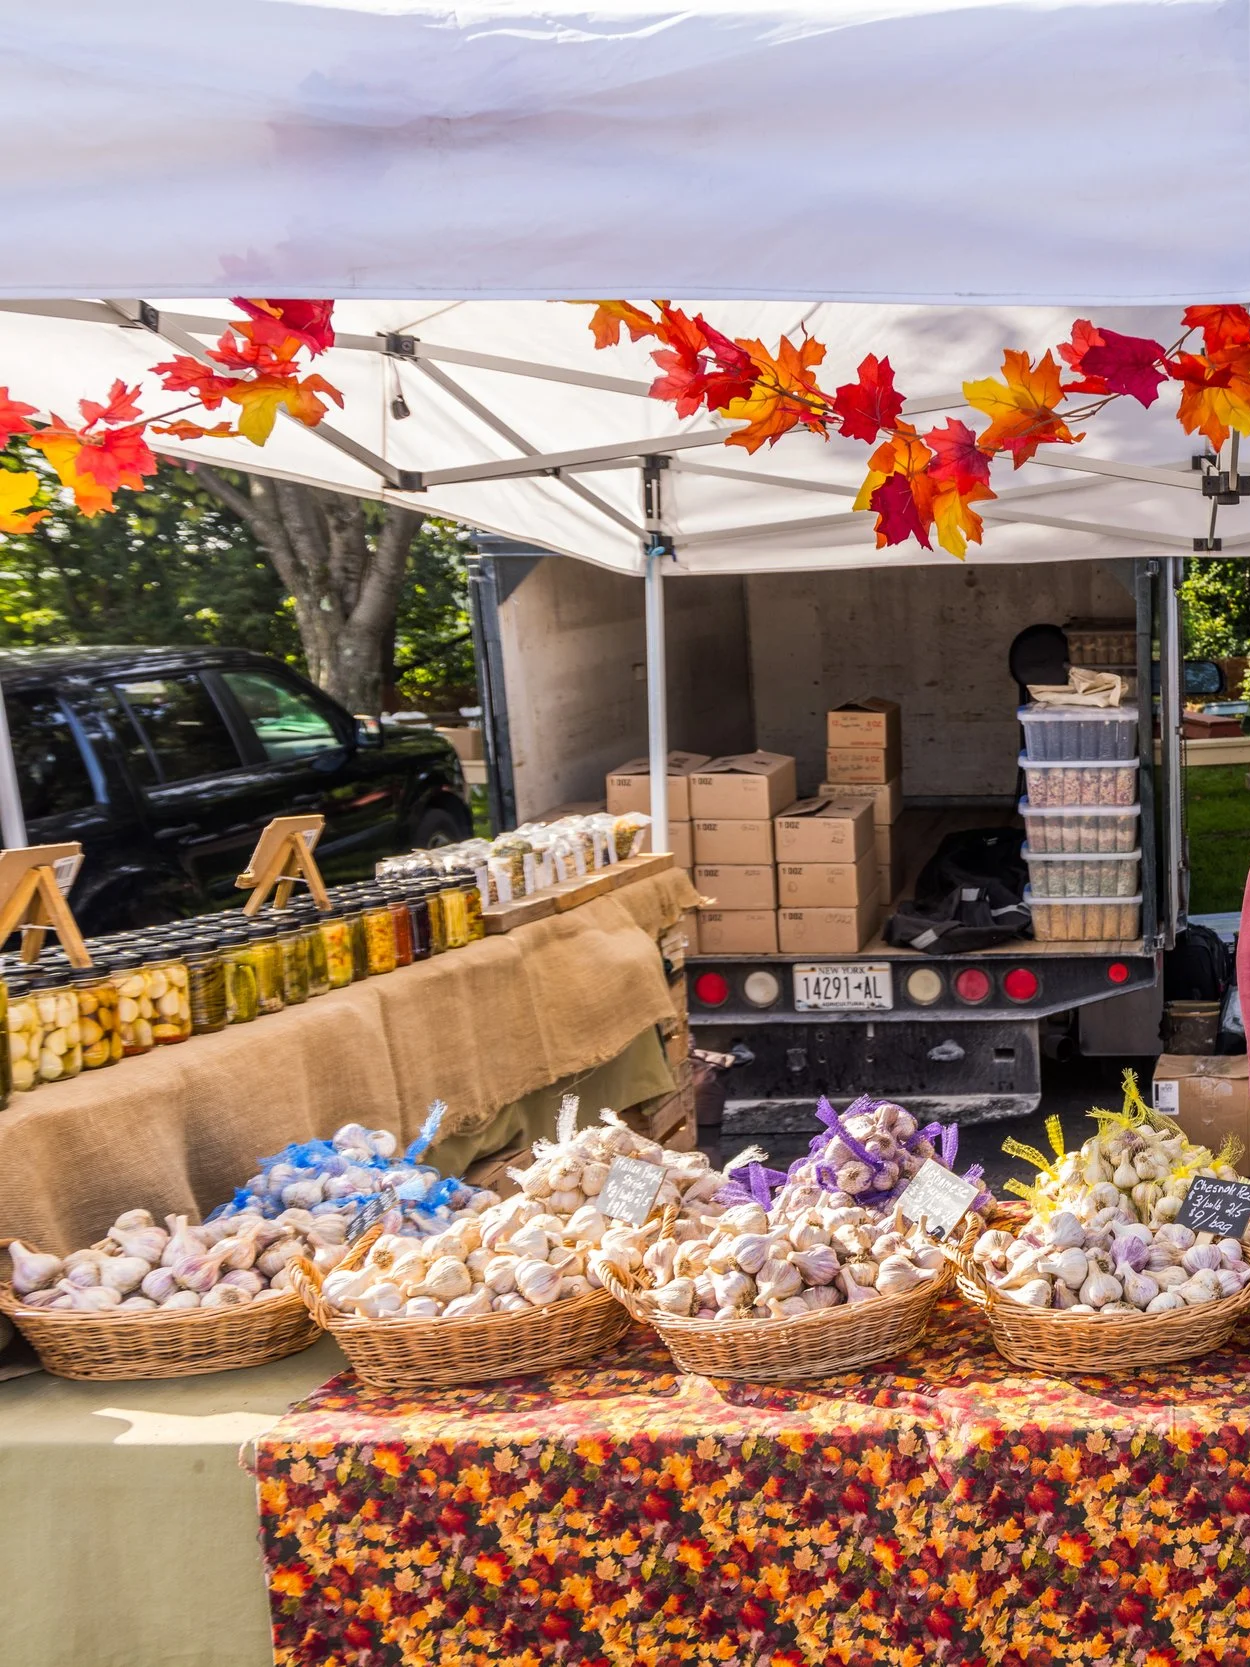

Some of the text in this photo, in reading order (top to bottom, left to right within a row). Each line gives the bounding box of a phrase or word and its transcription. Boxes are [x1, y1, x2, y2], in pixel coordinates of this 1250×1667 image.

[818, 966, 866, 974] NEW YORK
[803, 976, 882, 1000] 14291 AL
[1194, 1179, 1237, 1196] Chesnok
[1188, 1207, 1233, 1235] $9/bag
